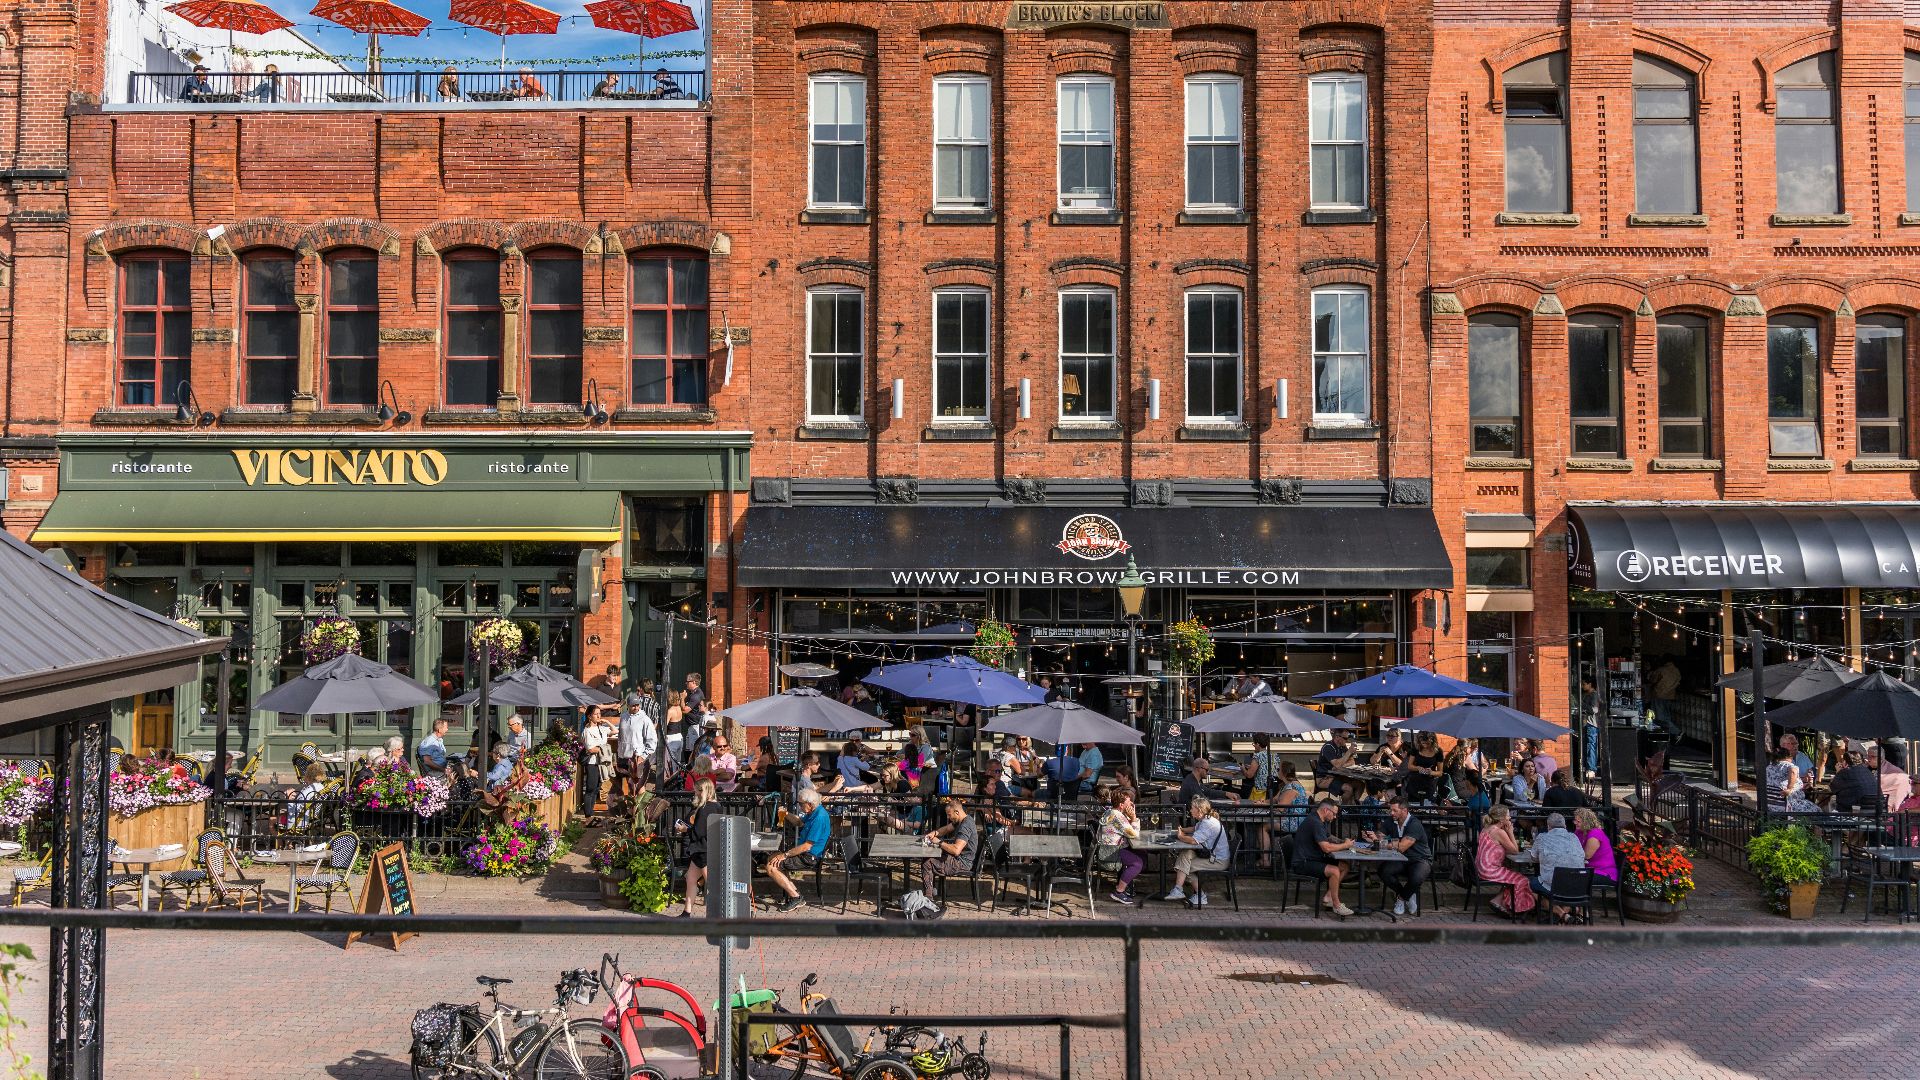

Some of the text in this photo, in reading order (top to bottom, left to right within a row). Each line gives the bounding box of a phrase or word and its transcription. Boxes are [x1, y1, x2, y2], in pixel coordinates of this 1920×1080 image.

[1019, 5, 1161, 21] BROWN'S BLOCK
[112, 461, 193, 473] ristorante
[231, 449, 448, 486] VICINATO
[488, 461, 569, 473] ristorante
[1091, 538, 1120, 549] BROWN
[1652, 554, 1784, 576] RECEIVER
[891, 571, 1300, 585] WWW.JOHNBROWGRILLE.COM
